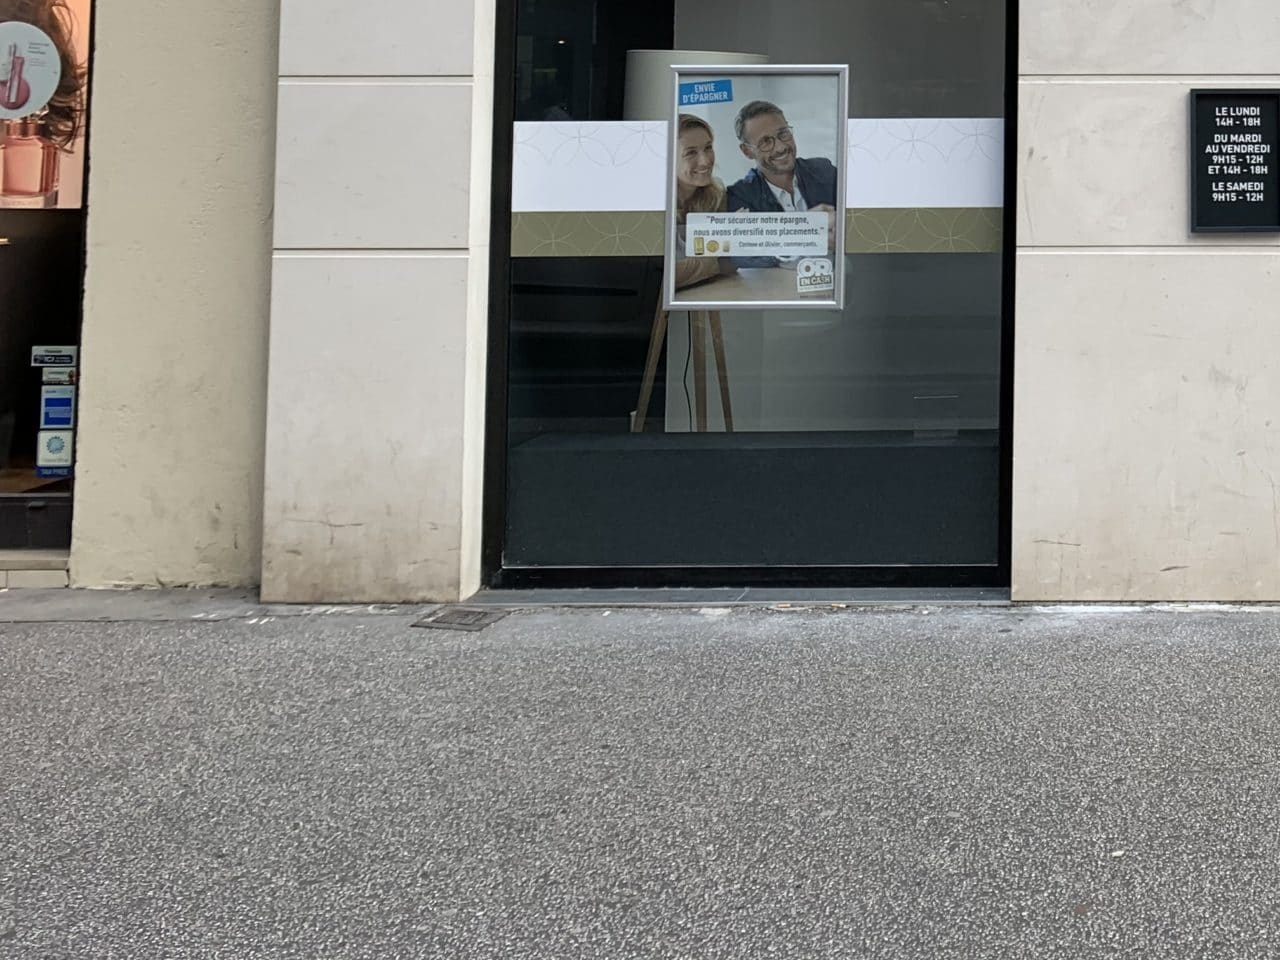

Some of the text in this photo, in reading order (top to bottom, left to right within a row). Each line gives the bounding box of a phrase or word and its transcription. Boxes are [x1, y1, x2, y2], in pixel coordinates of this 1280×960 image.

[694, 83, 716, 93] ENVIE
[682, 90, 729, 104] D'ÉPARGNER
[1215, 107, 1260, 116] LE LUNDI
[1215, 118, 1233, 126] 14H
[1243, 118, 1261, 126] 18H
[1214, 134, 1262, 143] DU MARDI
[1205, 145, 1270, 153] AU VENDREDI
[1212, 155, 1237, 164] 9H15
[1246, 155, 1263, 164] 12H
[1208, 166, 1221, 174] ET
[1223, 166, 1241, 174] 14H
[1250, 166, 1268, 174] 18H
[1212, 182, 1264, 191] LE SAMEDI
[1212, 193, 1237, 201] 9H15
[1246, 193, 1264, 201] 12H
[728, 215, 759, 225] sécuriser
[761, 216, 778, 224] notre
[693, 228, 709, 236] nous
[711, 228, 731, 236] avons
[733, 226, 764, 236] diversifié
[765, 227, 778, 235] nos
[799, 259, 831, 278] OR
